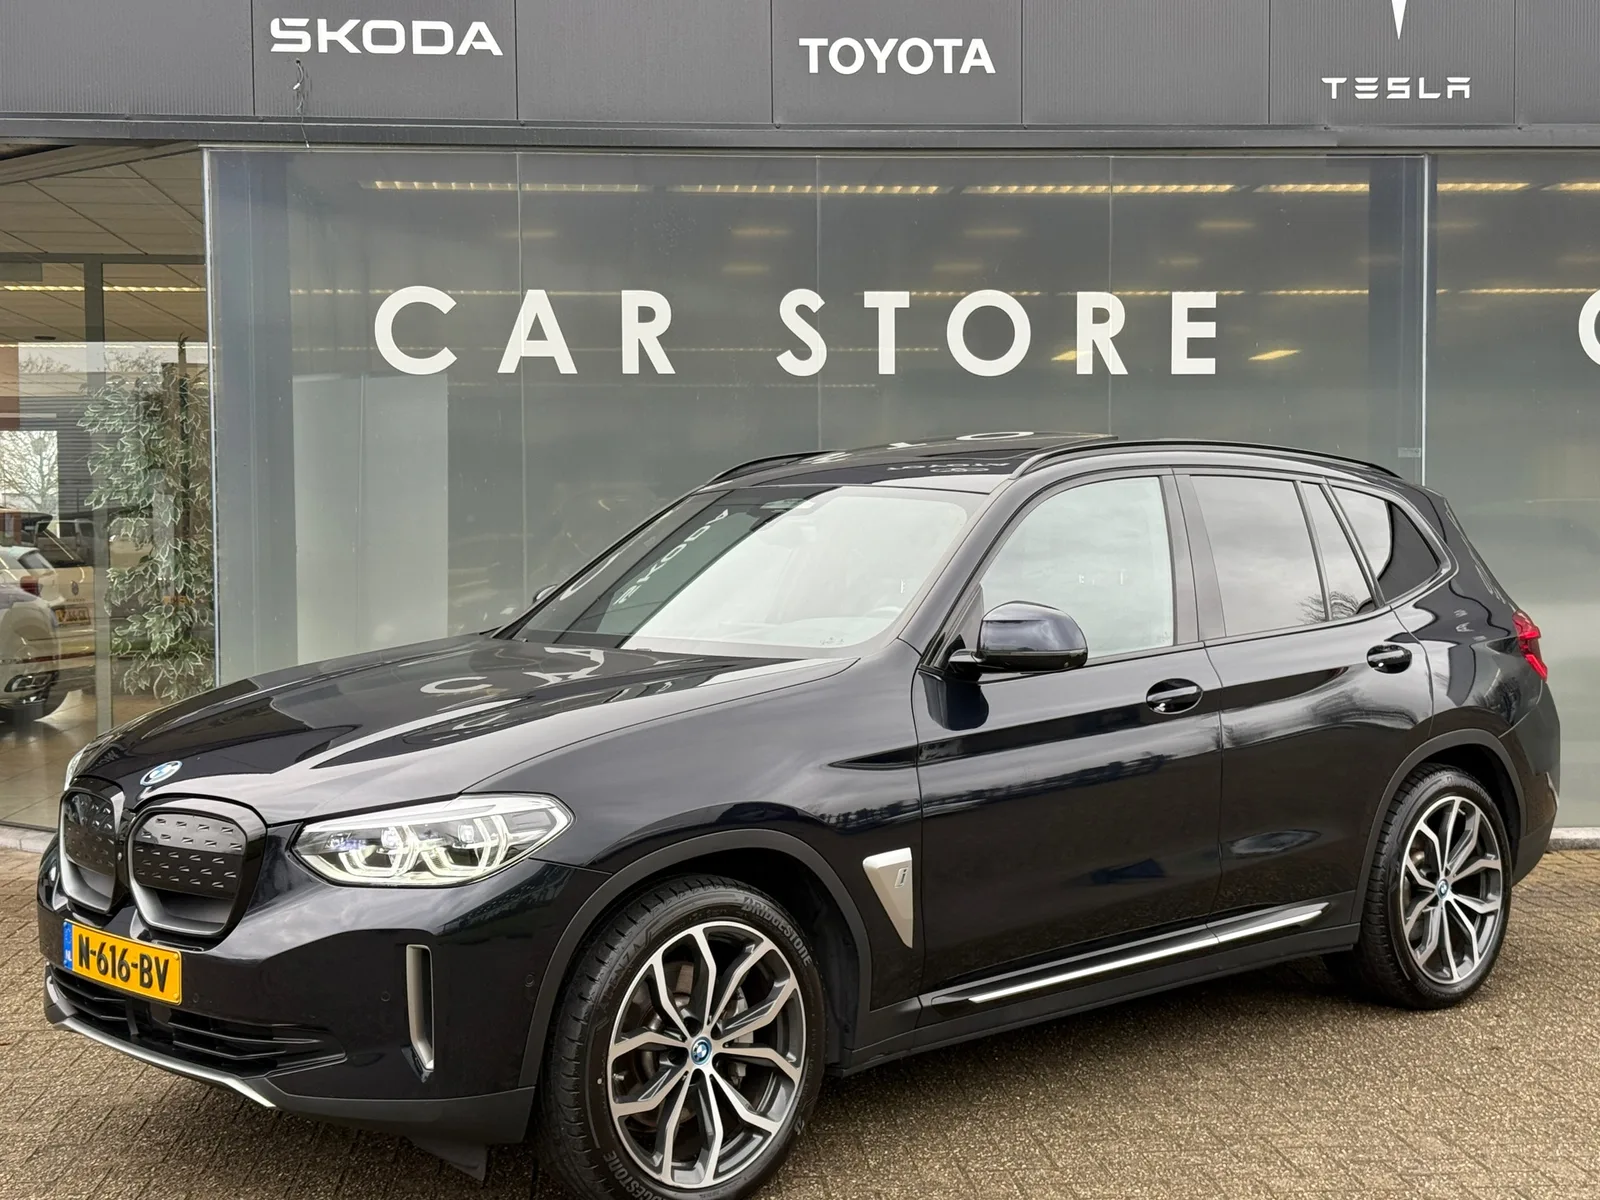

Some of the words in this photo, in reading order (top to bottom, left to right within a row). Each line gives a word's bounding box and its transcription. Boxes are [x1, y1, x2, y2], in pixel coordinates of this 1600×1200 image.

[798, 36, 996, 75] TOYOTA
[1321, 77, 1471, 100] TESLA
[374, 285, 676, 376] CAR
[776, 288, 1218, 378] STORE
[741, 896, 813, 967] BRIDGESTONE
[78, 933, 170, 993] N-616-BV
[603, 1150, 666, 1200] GESTONE
